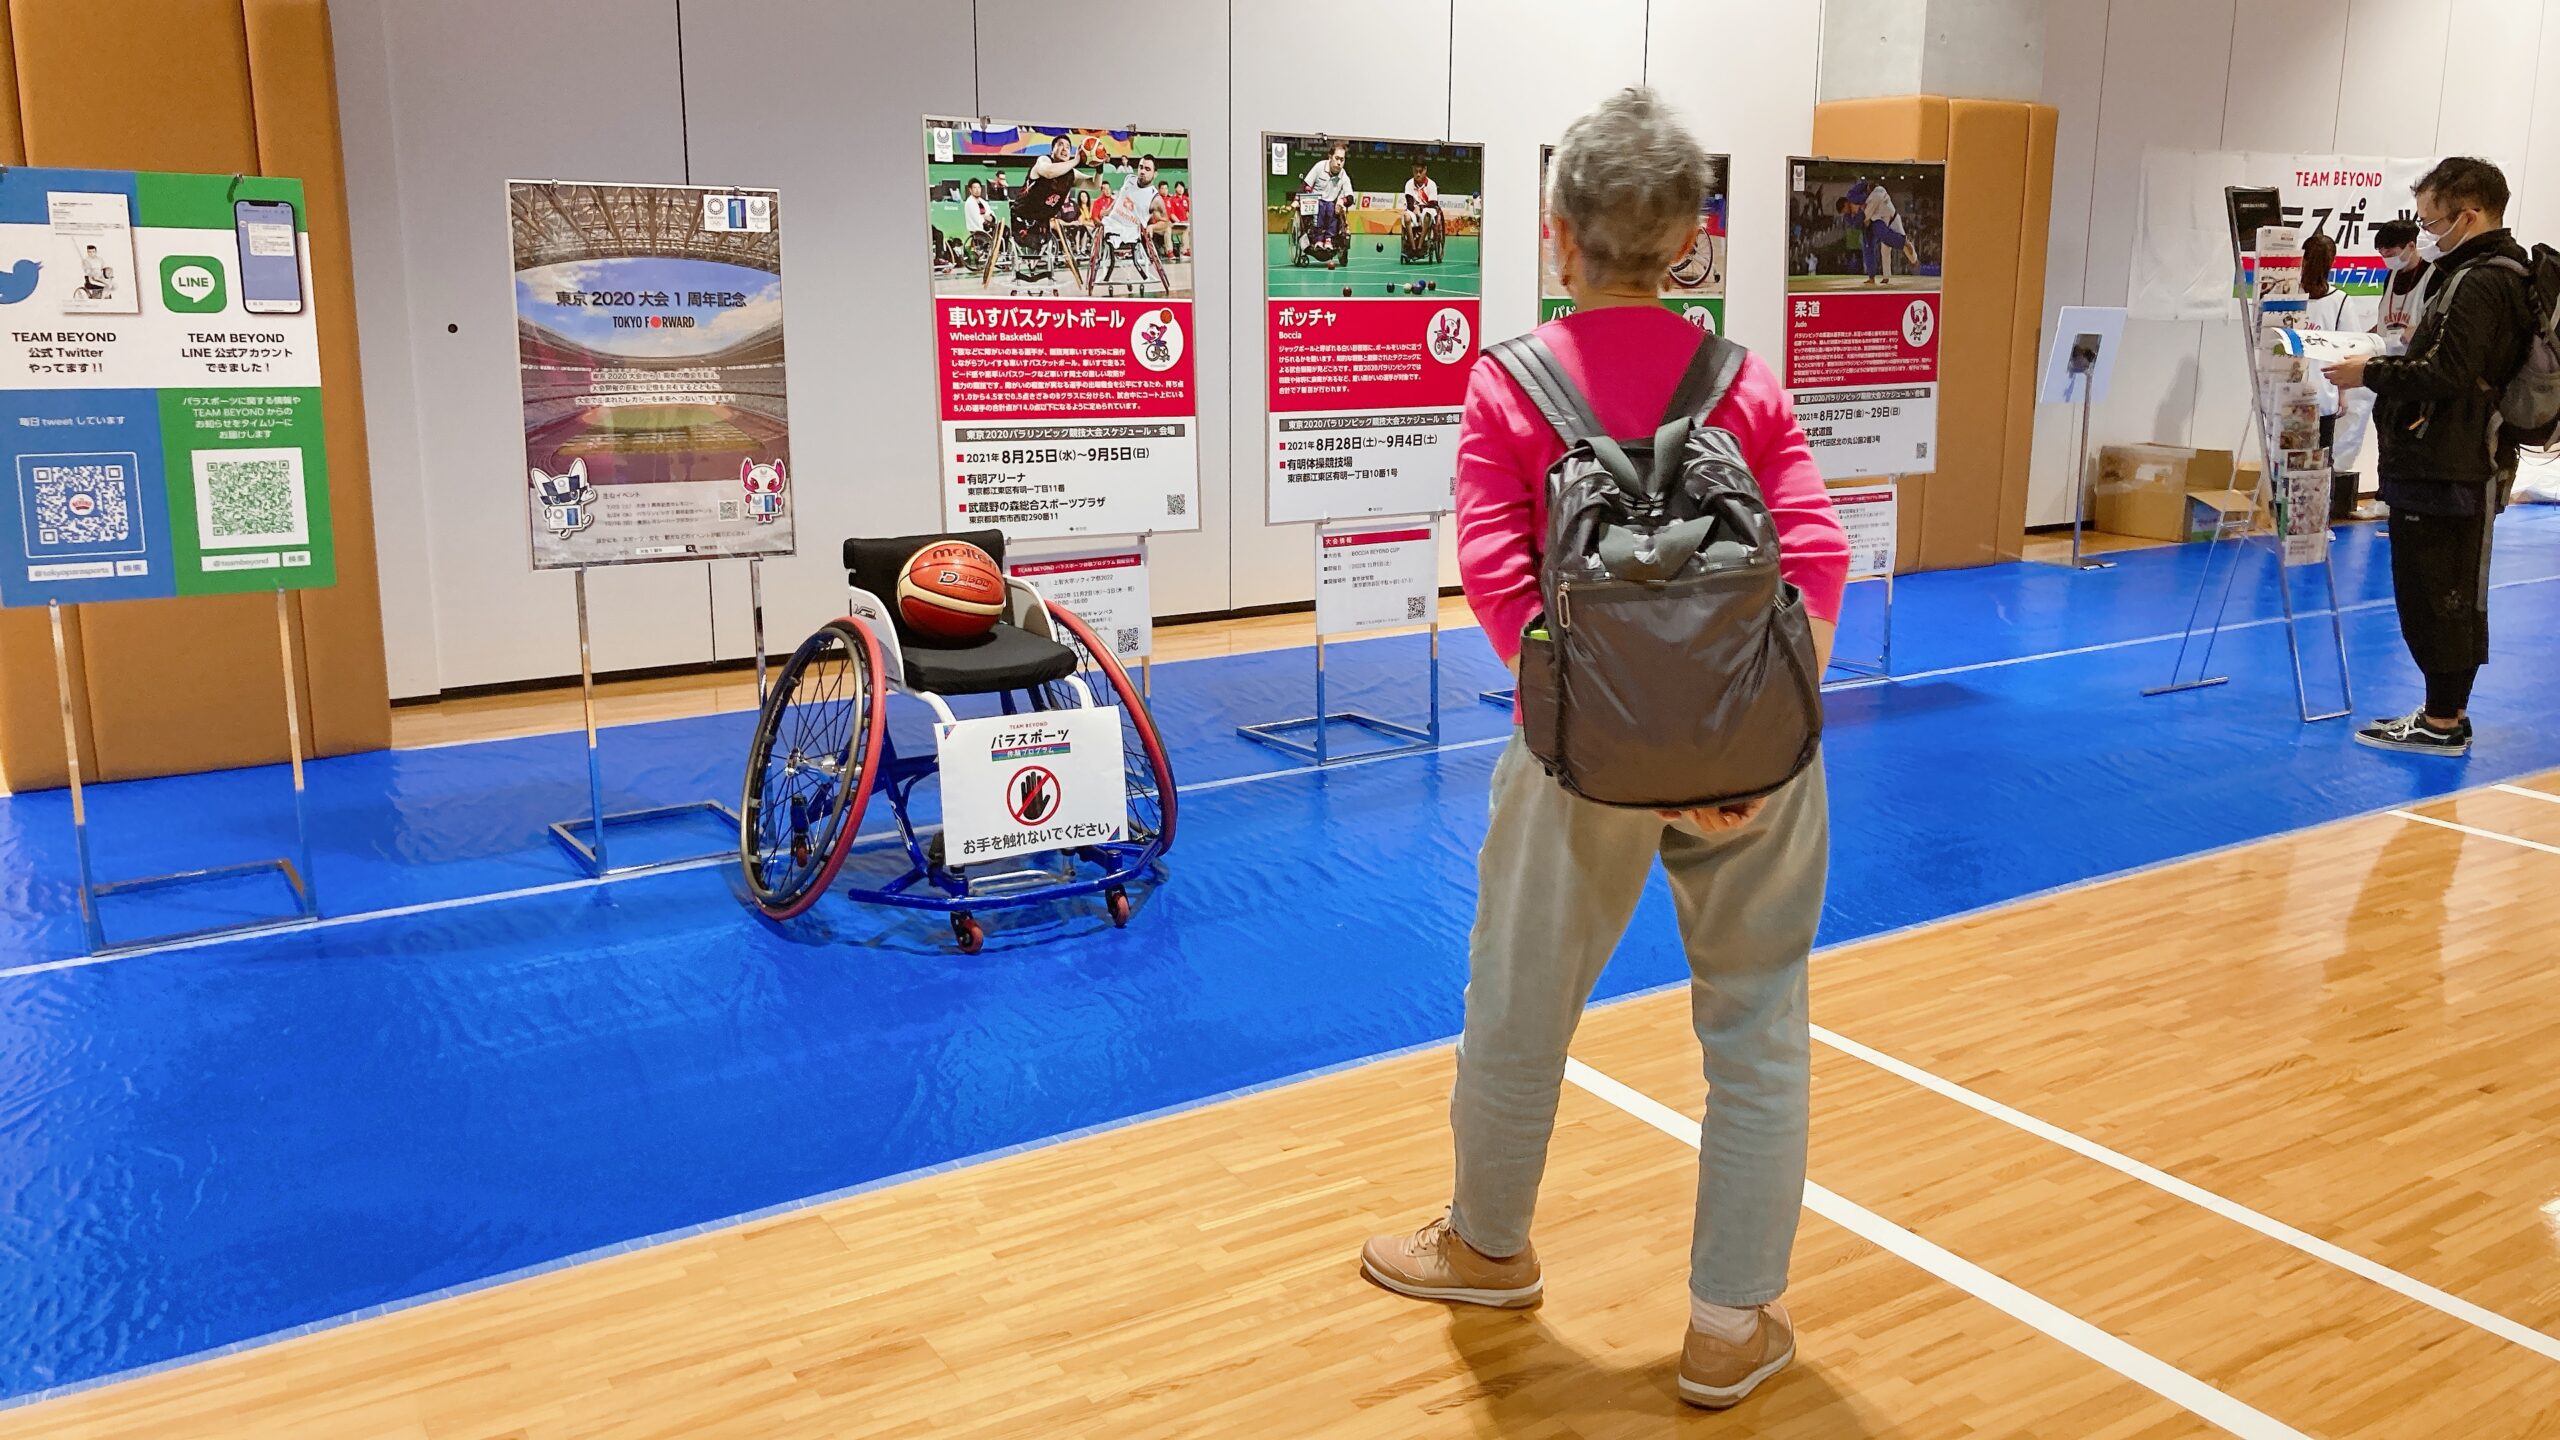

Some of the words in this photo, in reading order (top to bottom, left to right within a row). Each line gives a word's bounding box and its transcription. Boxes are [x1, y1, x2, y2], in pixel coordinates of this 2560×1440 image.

[2296, 172, 2330, 187] TEAM
[2334, 172, 2382, 187] BEYOND
[178, 276, 209, 288] LINE
[556, 291, 588, 307] 東京
[592, 292, 635, 306] 2020
[639, 291, 670, 307] 大会
[688, 292, 747, 308] 周年記念
[1794, 300, 1820, 318] 柔道
[613, 316, 643, 328] TOKYO
[949, 306, 1126, 328] 車いすバスケットボール
[1279, 307, 1336, 327] ボッチャ
[12, 332, 52, 343] TEAM
[56, 332, 117, 342] BEYOND
[188, 333, 226, 344] TEAM
[230, 333, 285, 344] BEYOND
[950, 332, 998, 342] Wheelchair
[1000, 332, 1043, 342] Basketball
[1278, 332, 1302, 340] Boccia
[29, 348, 53, 359] 公式
[58, 348, 104, 358] Twitter
[182, 348, 212, 358] LINE
[215, 348, 294, 359] 公式アカウント
[206, 362, 271, 374] できました！
[193, 408, 221, 418] TEAM
[224, 408, 264, 416] BEYOND
[267, 407, 294, 416] からの
[42, 416, 74, 426] tweet
[76, 416, 126, 426] しています
[195, 418, 294, 428] お知らせをタイムリーに
[966, 426, 1176, 441] 東京2020パラリンピック競技大会スケジュール・会場
[1803, 426, 1833, 436] 本武道館
[1288, 441, 1314, 451] 2021年
[966, 452, 1000, 463] 2021年
[1287, 456, 1353, 470] 有明体操競技場
[967, 472, 1026, 485] 有明アリーナ
[1287, 468, 1398, 483] 東京都江東区有明一丁目10番1号
[968, 496, 1106, 514] 武蔵野の森総合スポーツプラザ
[933, 548, 997, 574] molten
[991, 729, 1070, 749] パラスポーツ
[963, 822, 1111, 854] お手を触れないでください
